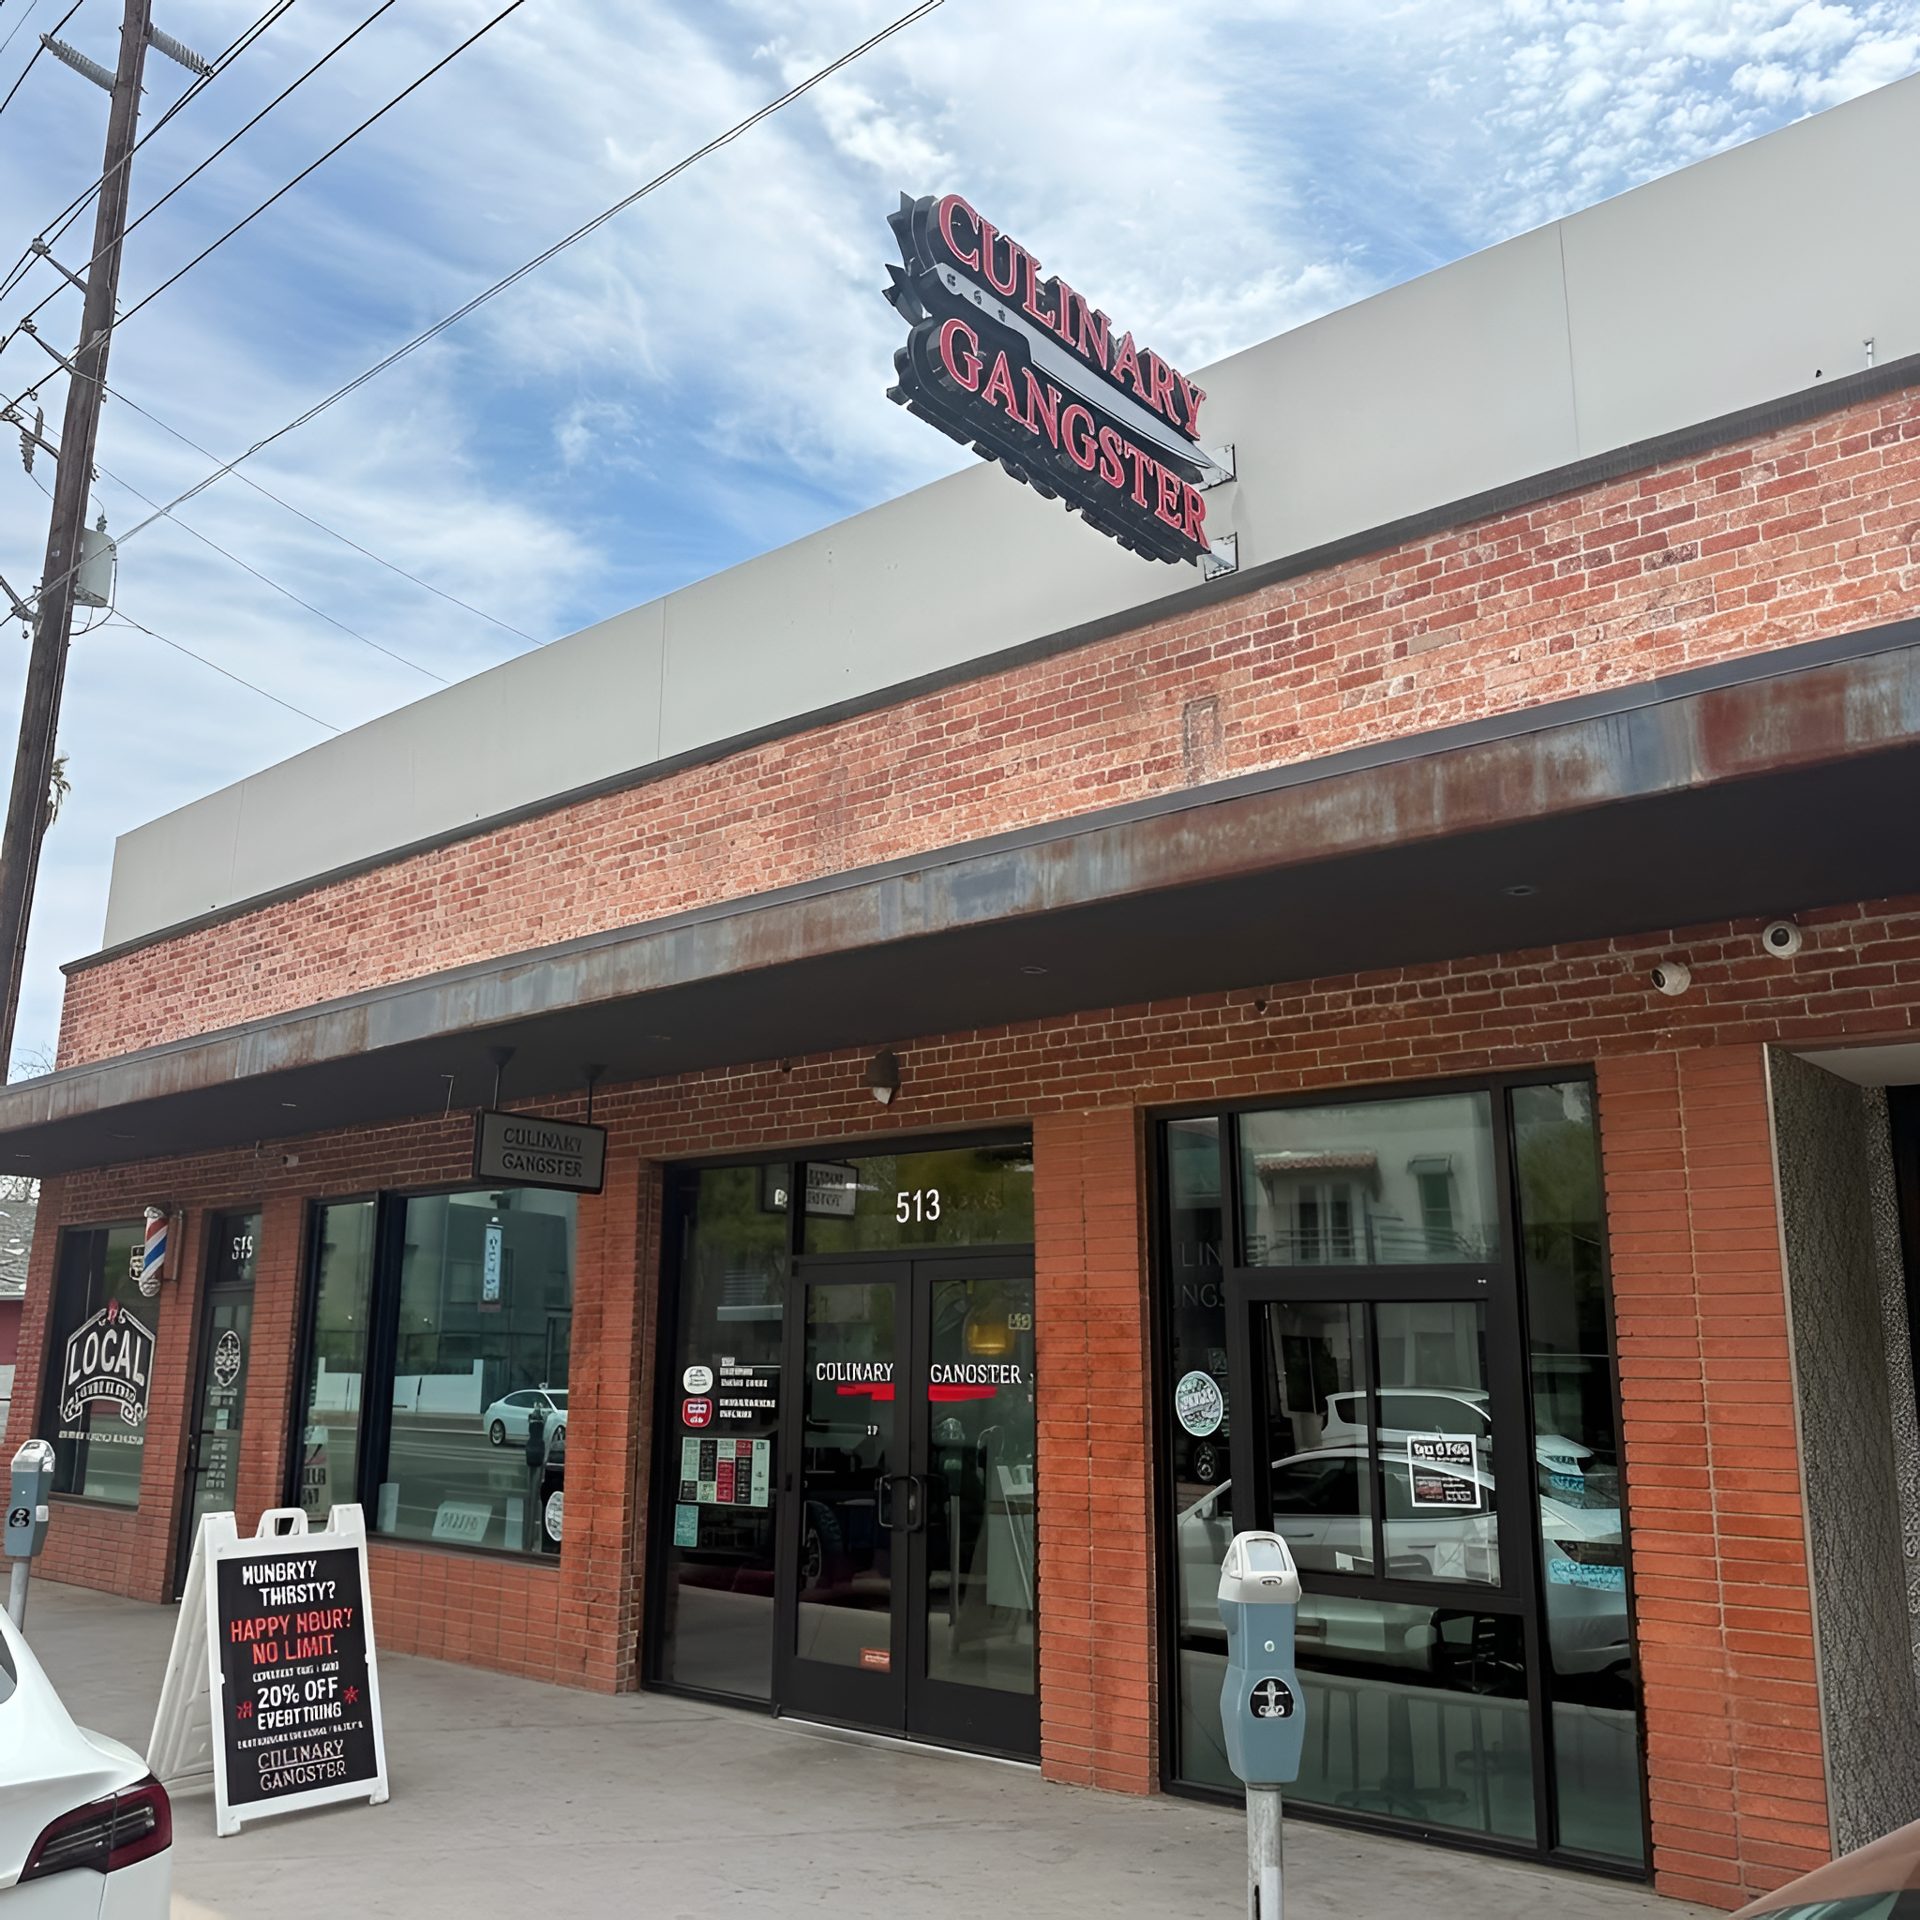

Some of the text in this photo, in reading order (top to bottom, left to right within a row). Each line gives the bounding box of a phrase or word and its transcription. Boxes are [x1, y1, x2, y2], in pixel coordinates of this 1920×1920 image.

[939, 194, 1206, 440] CULINARY
[940, 318, 1211, 554] GANGSTER
[896, 1188, 941, 1223] 513
[68, 1328, 145, 1386] LOCAL
[230, 1614, 290, 1643] HAPPY
[252, 1641, 279, 1665] NO
[257, 1676, 339, 1709] 20% OFF
